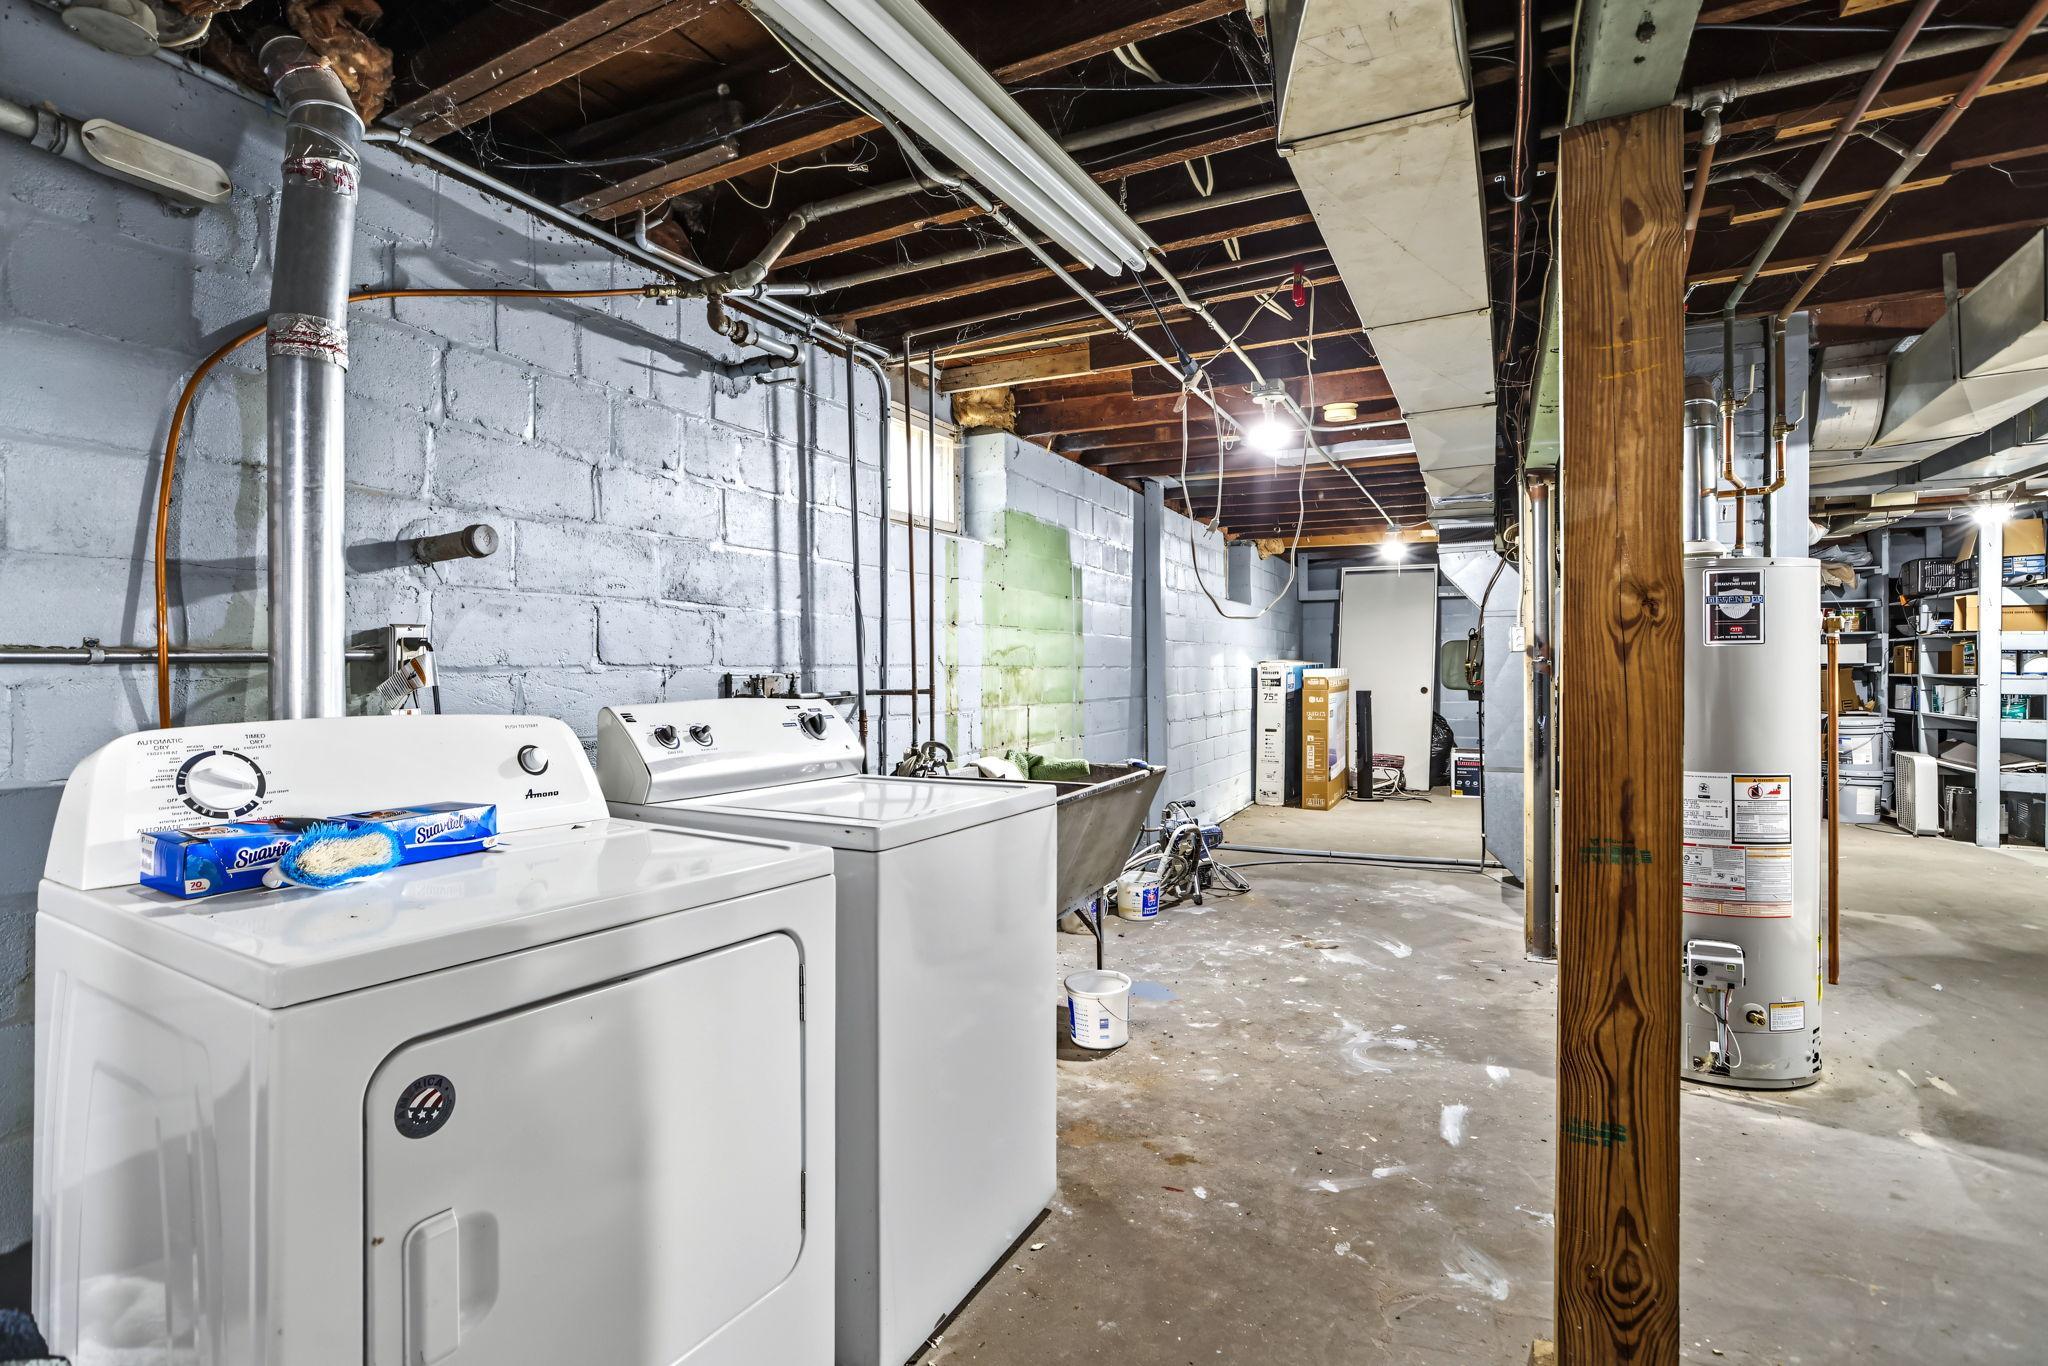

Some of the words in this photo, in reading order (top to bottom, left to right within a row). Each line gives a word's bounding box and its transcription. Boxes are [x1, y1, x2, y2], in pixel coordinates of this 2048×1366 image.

[137, 738, 184, 746] AUTOMATIC
[416, 814, 464, 844] Suavitel
[235, 841, 291, 868] Suavit
